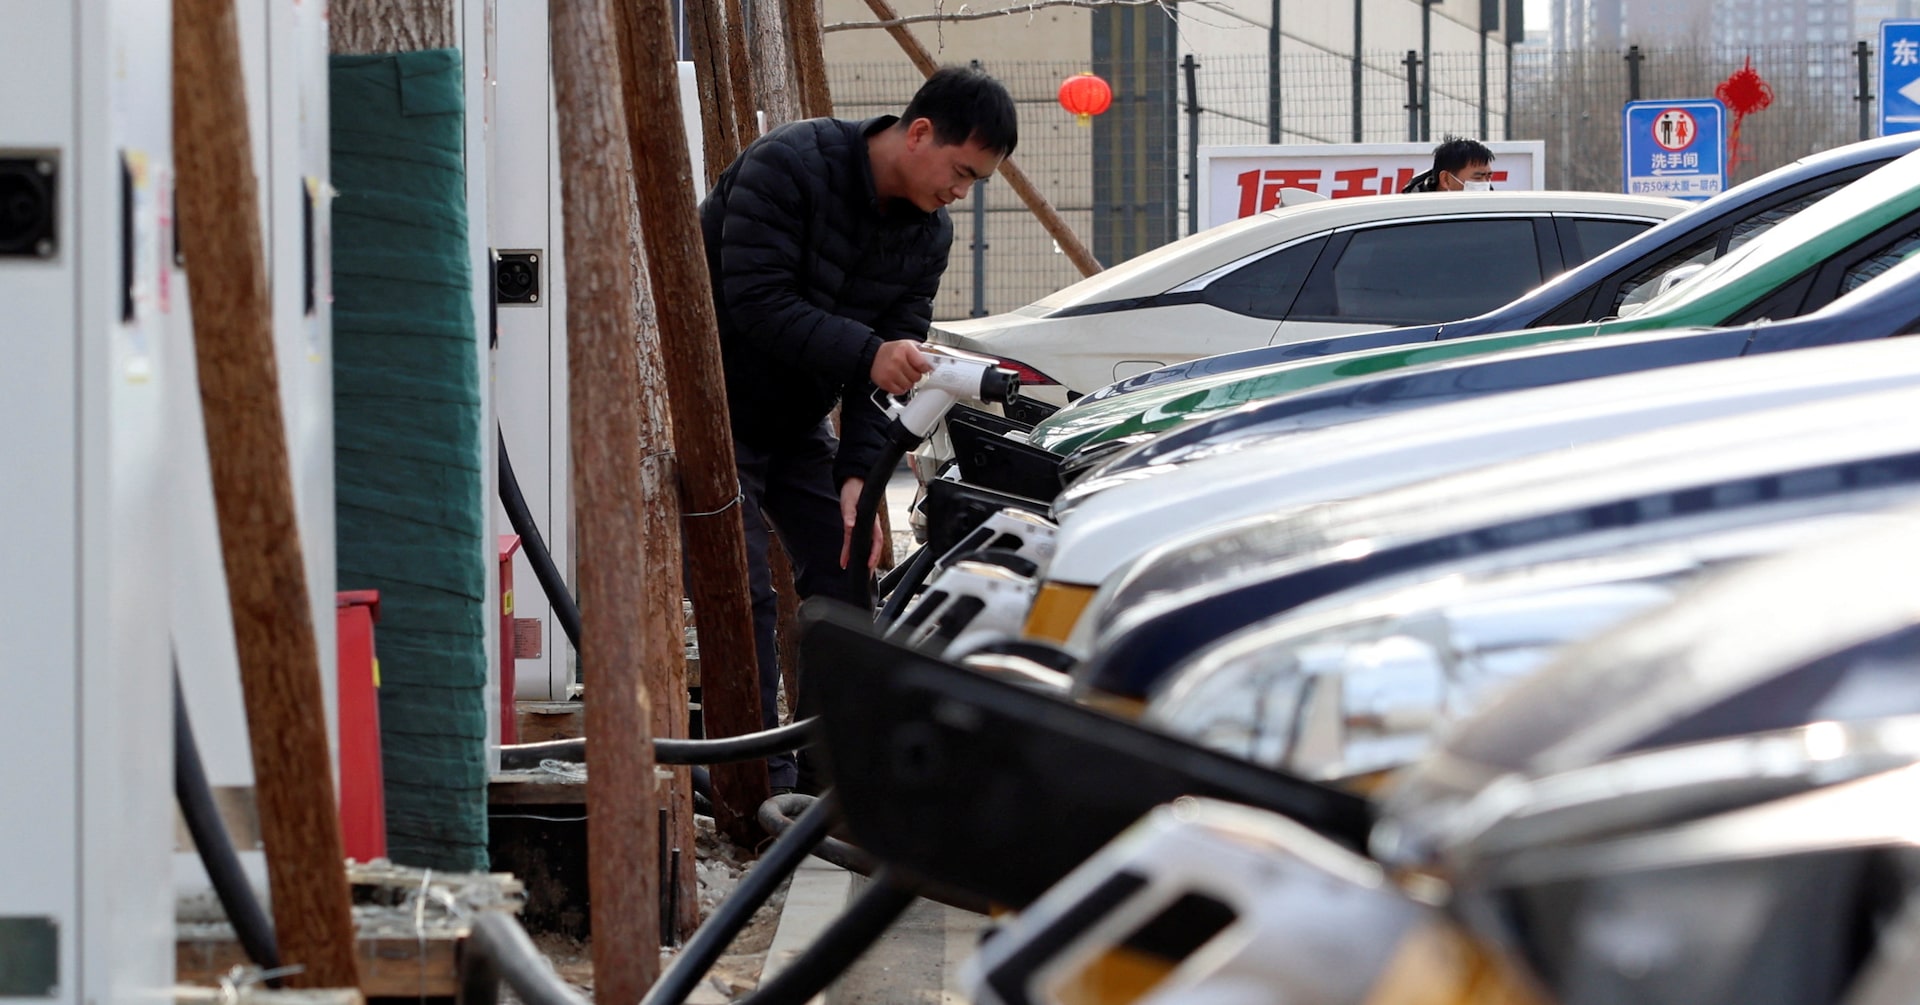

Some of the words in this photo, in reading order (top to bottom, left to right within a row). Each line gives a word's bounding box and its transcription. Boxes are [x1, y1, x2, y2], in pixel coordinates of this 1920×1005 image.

[1891, 38, 1919, 66] 东
[1651, 152, 1698, 169] 洗手间
